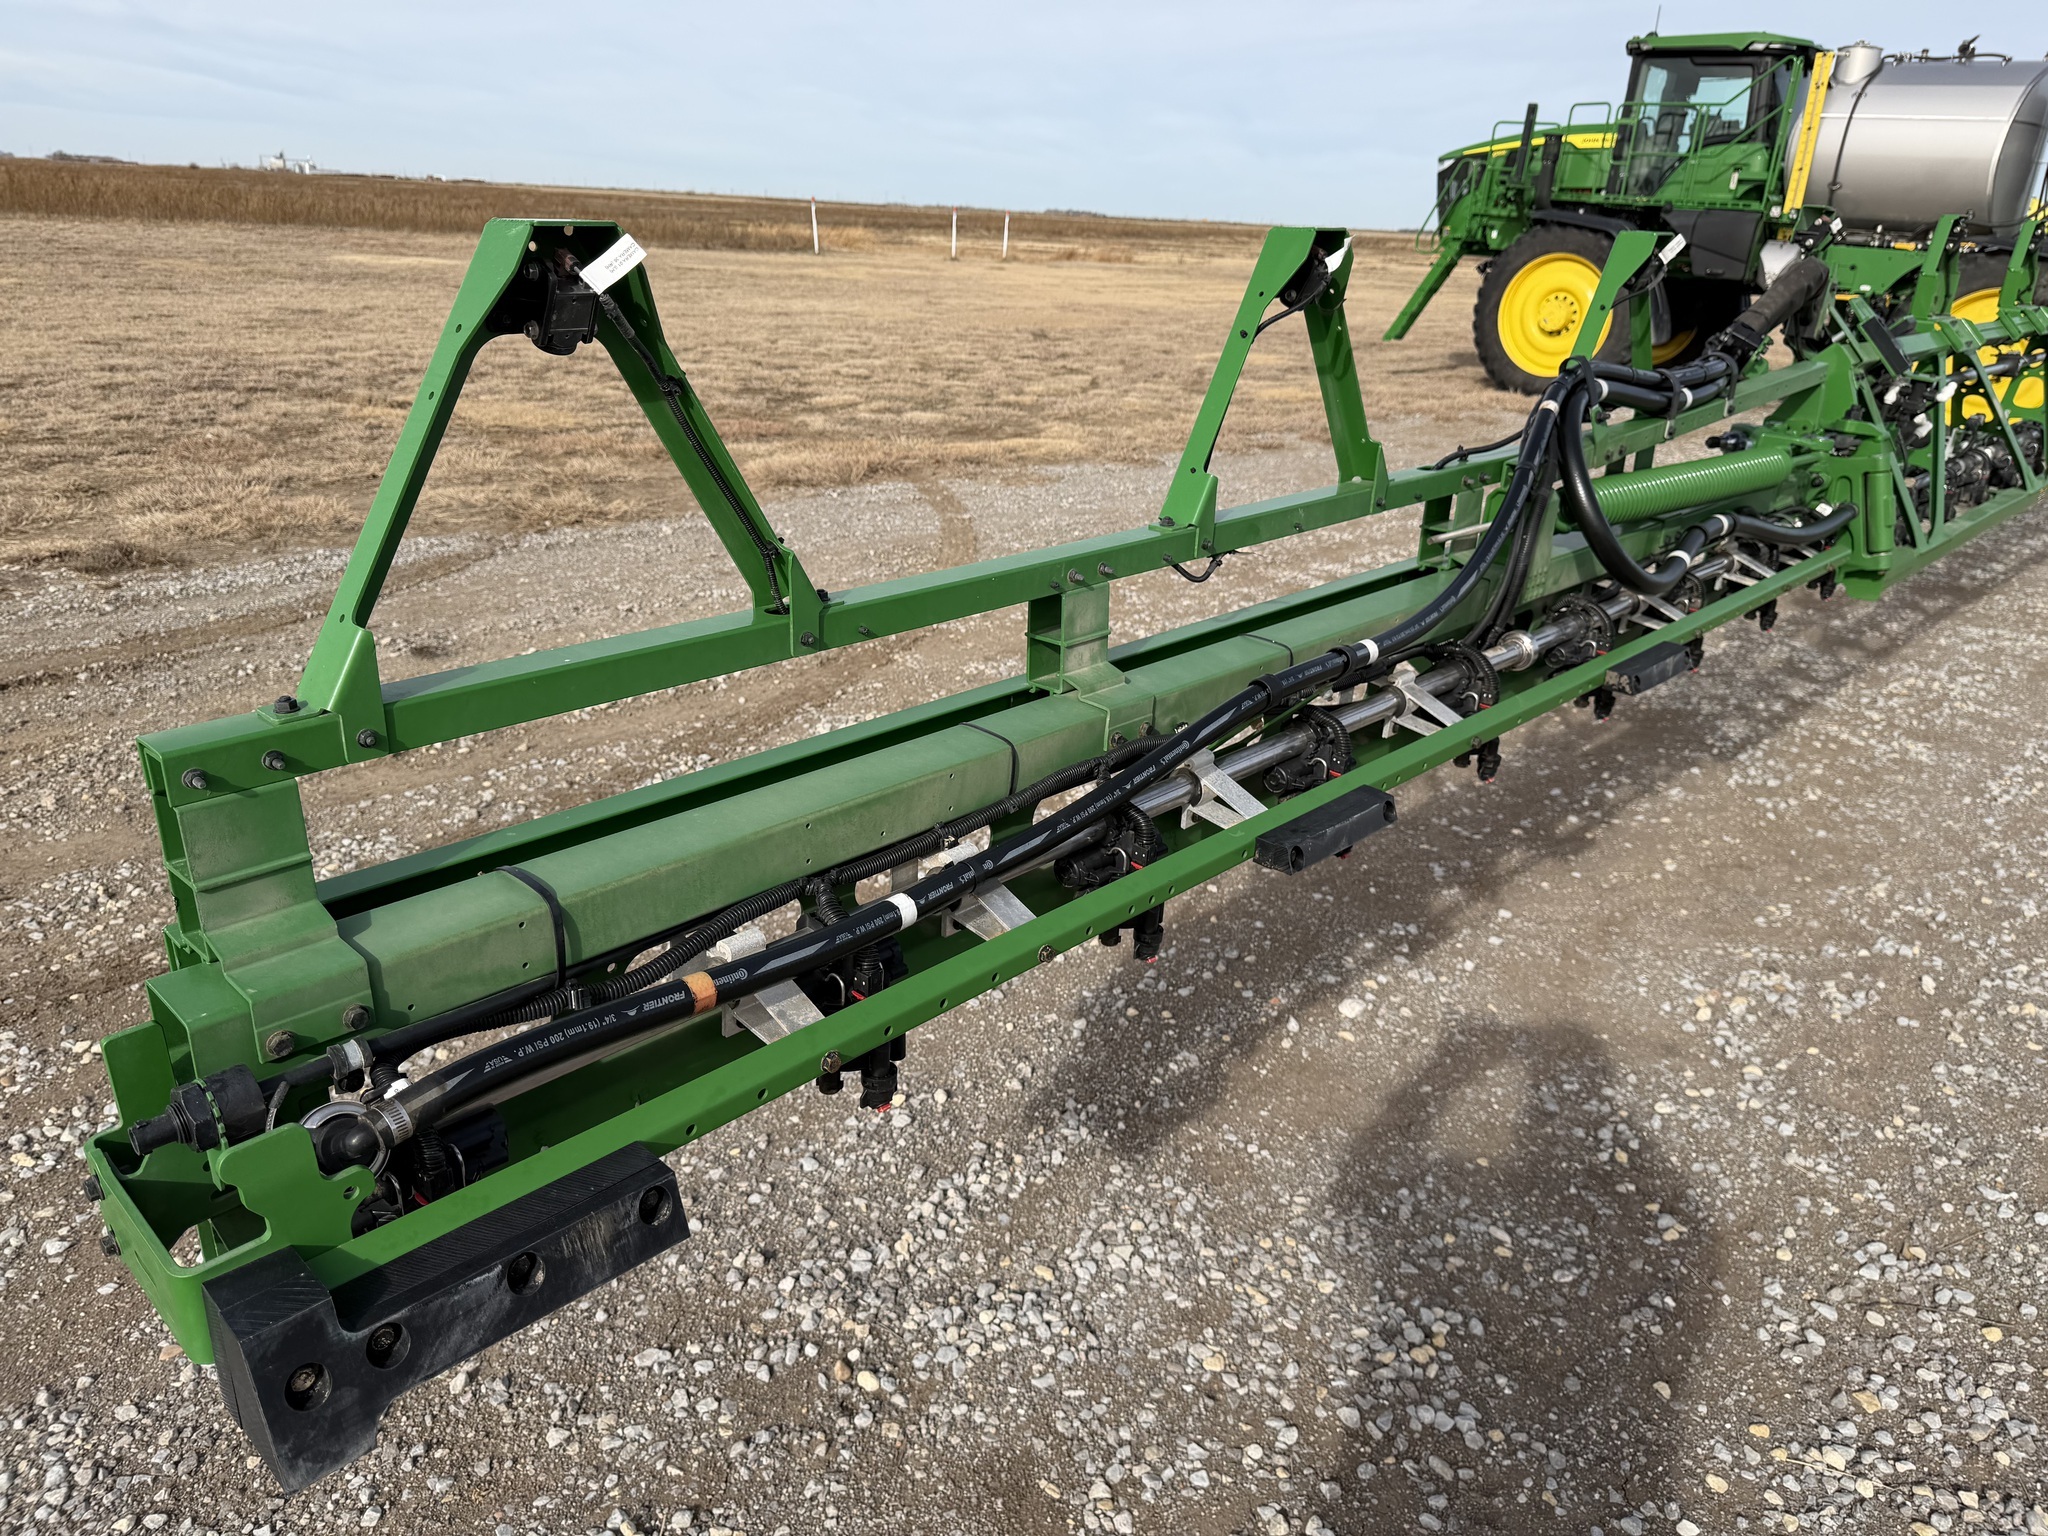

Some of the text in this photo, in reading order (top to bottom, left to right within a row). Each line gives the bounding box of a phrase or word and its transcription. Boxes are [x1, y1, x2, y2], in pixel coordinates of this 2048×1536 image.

[1163, 740, 1189, 762] Continental
[1133, 765, 1156, 784] FRONTIER
[928, 882, 953, 900] FRONTIER
[865, 921, 874, 930] PSI
[713, 968, 748, 988] Continen
[643, 991, 685, 1010] FRONTIER
[564, 1018, 600, 1038] (19.1mm)
[603, 1014, 616, 1025] 3/4"
[534, 1038, 549, 1050] PSI
[550, 1032, 564, 1043] 200
[514, 1045, 534, 1056] W.P.
